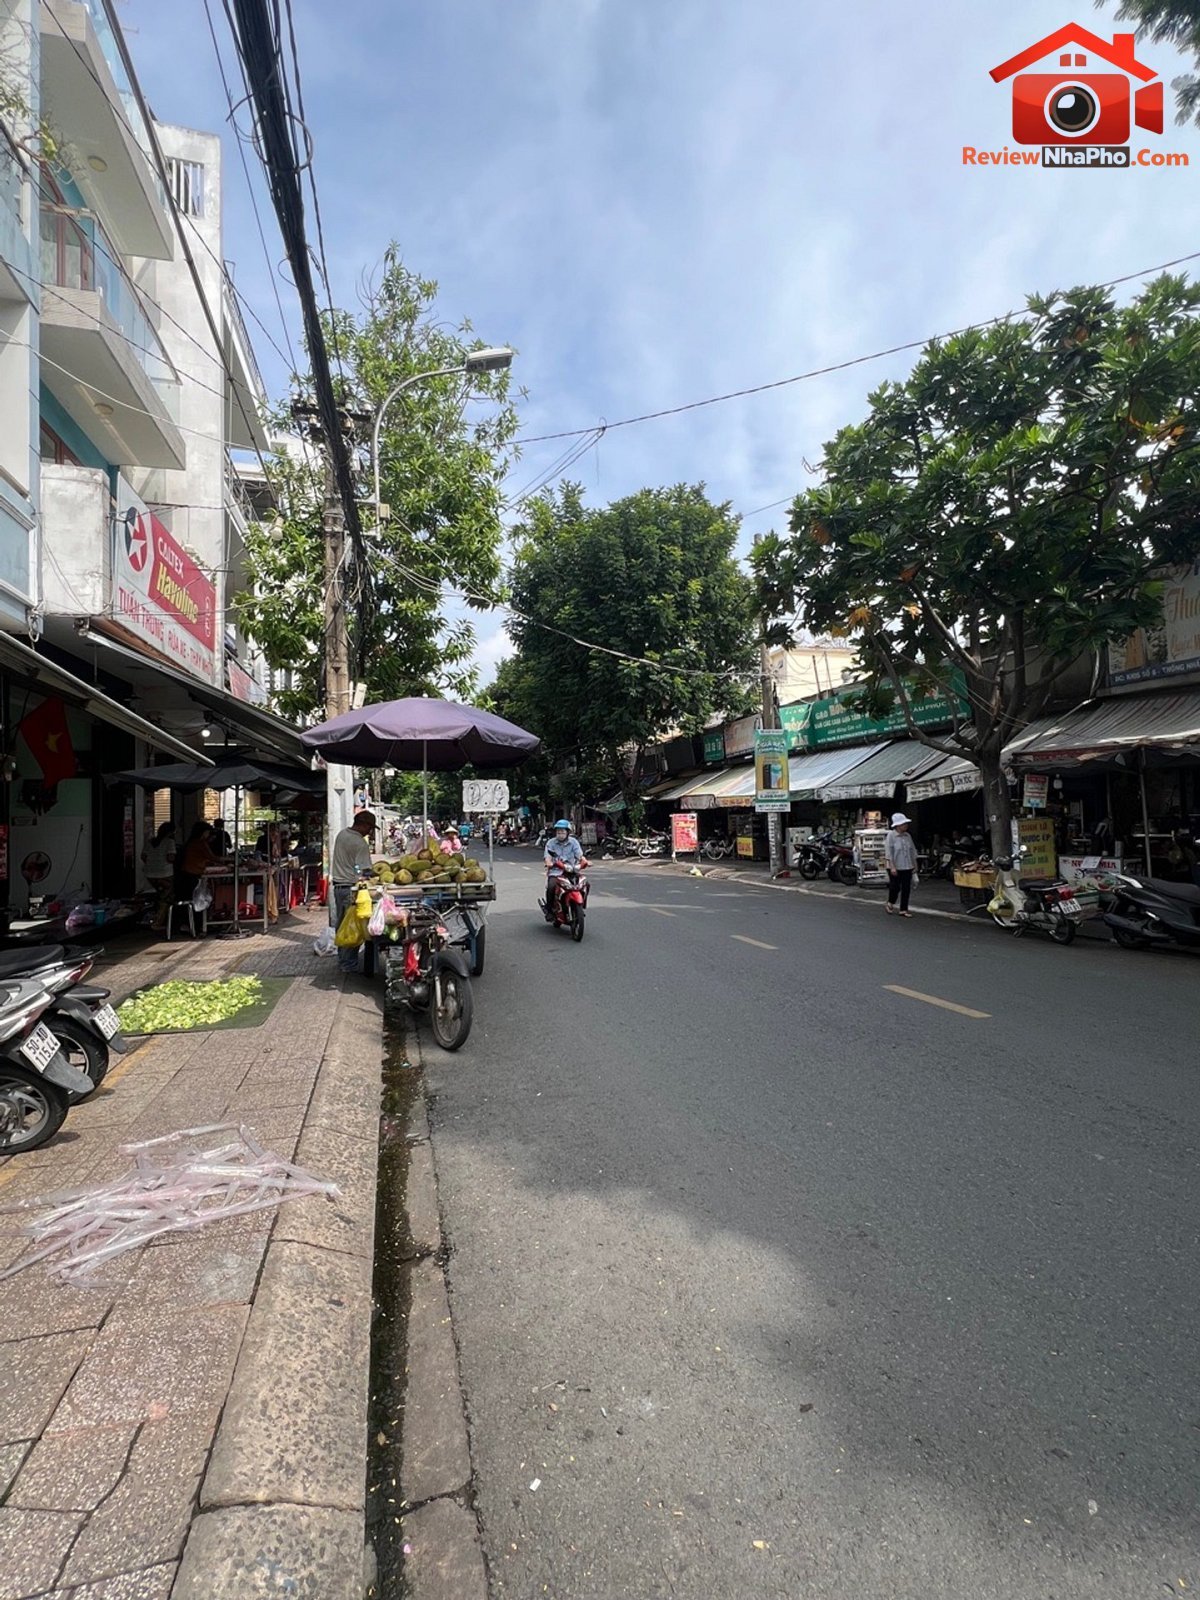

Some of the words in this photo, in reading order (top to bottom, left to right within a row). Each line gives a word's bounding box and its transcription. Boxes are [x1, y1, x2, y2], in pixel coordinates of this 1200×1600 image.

[157, 537, 184, 579] CALTEX
[156, 563, 199, 624] Havoline
[25, 1027, 48, 1055] 50-AD
[35, 1036, 59, 1067] 115.44
